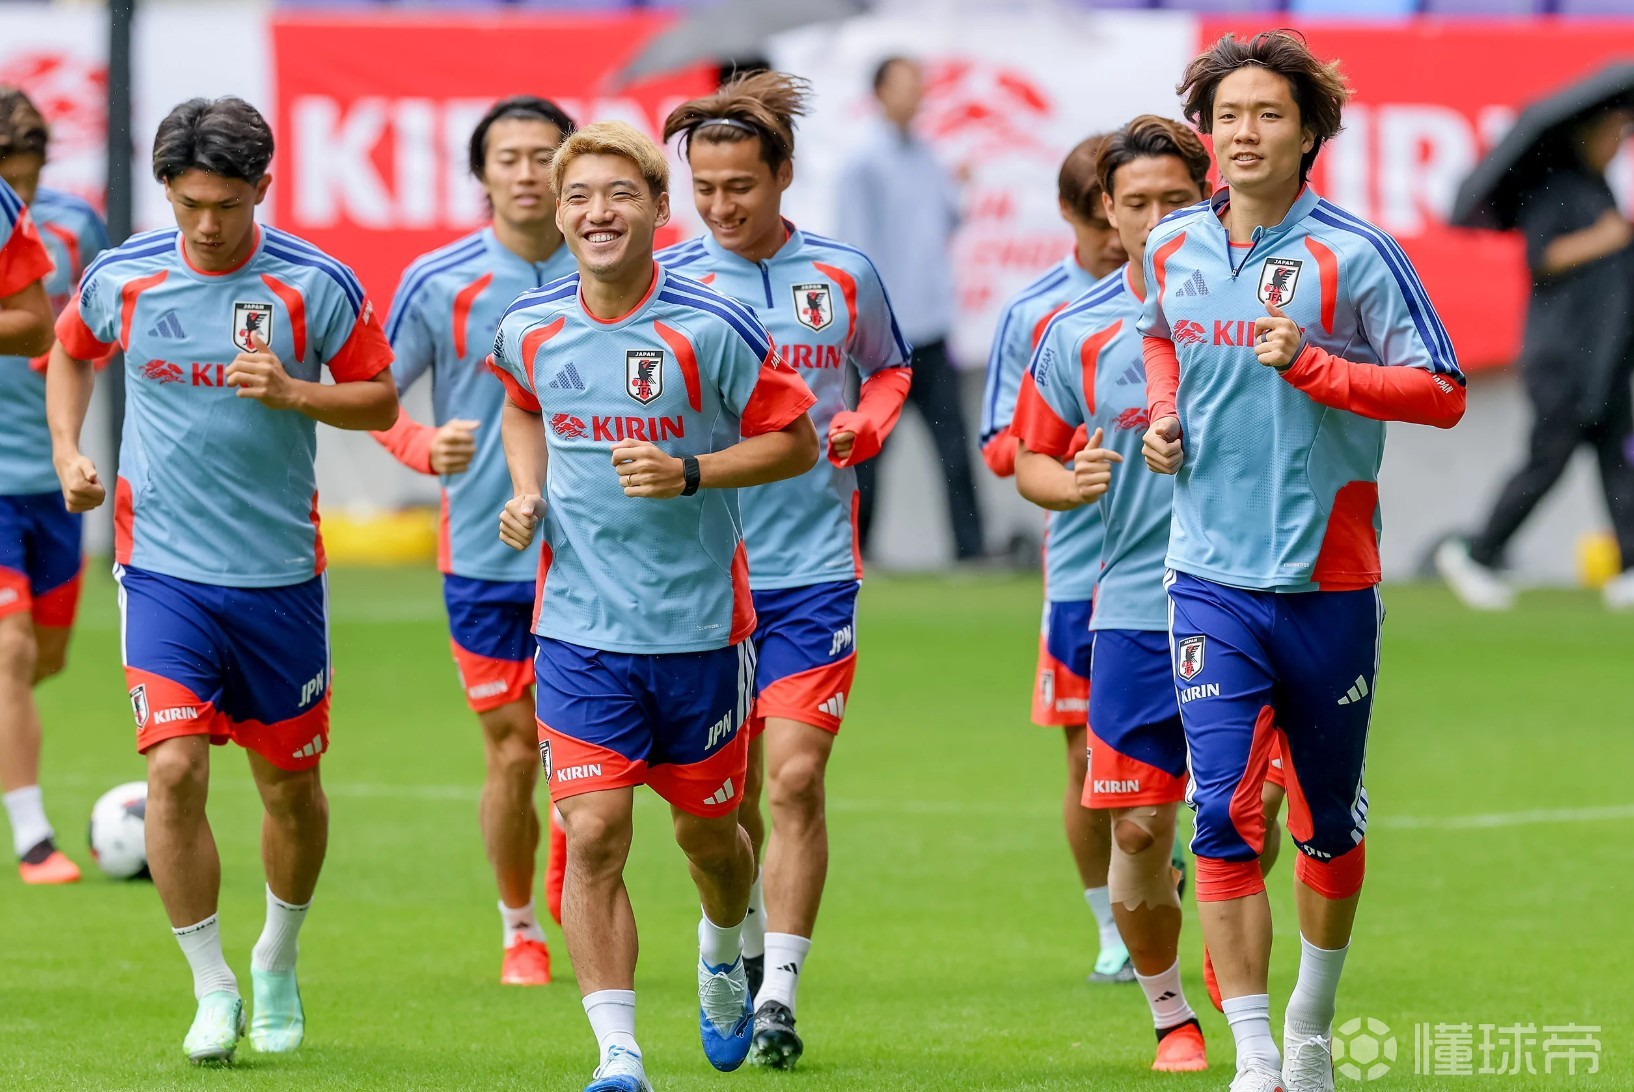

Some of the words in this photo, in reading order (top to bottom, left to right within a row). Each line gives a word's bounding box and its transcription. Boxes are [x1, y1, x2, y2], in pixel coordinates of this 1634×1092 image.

[1036, 347, 1055, 387] DREAM
[1432, 374, 1454, 394] JAPAN
[592, 416, 684, 441] KIRIN
[829, 625, 851, 656] JPN
[298, 668, 323, 707] JPN
[1181, 683, 1219, 704] KIRIN
[154, 706, 198, 724] KIRIN
[704, 709, 731, 750] JPN
[557, 764, 601, 782] KIRIN
[1093, 780, 1139, 793] KIRIN
